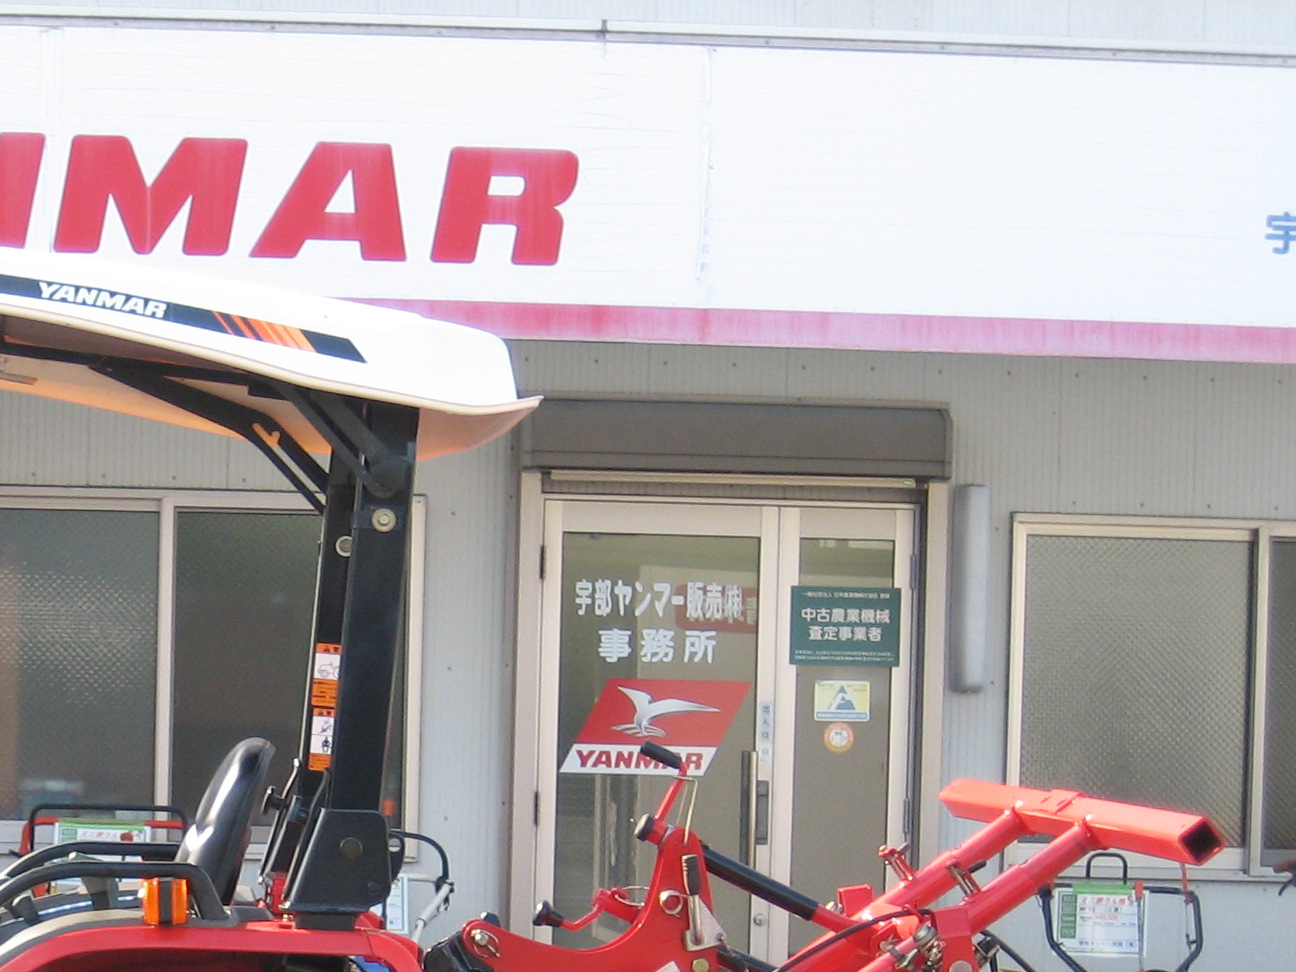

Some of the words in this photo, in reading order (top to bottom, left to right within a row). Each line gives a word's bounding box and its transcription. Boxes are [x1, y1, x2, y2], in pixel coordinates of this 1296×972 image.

[38, 281, 169, 319] YANMAR
[801, 607, 891, 624] 中古農業機械
[808, 625, 882, 642] 査定事業者
[598, 628, 717, 664] 事務所
[576, 749, 703, 771] YANMR
